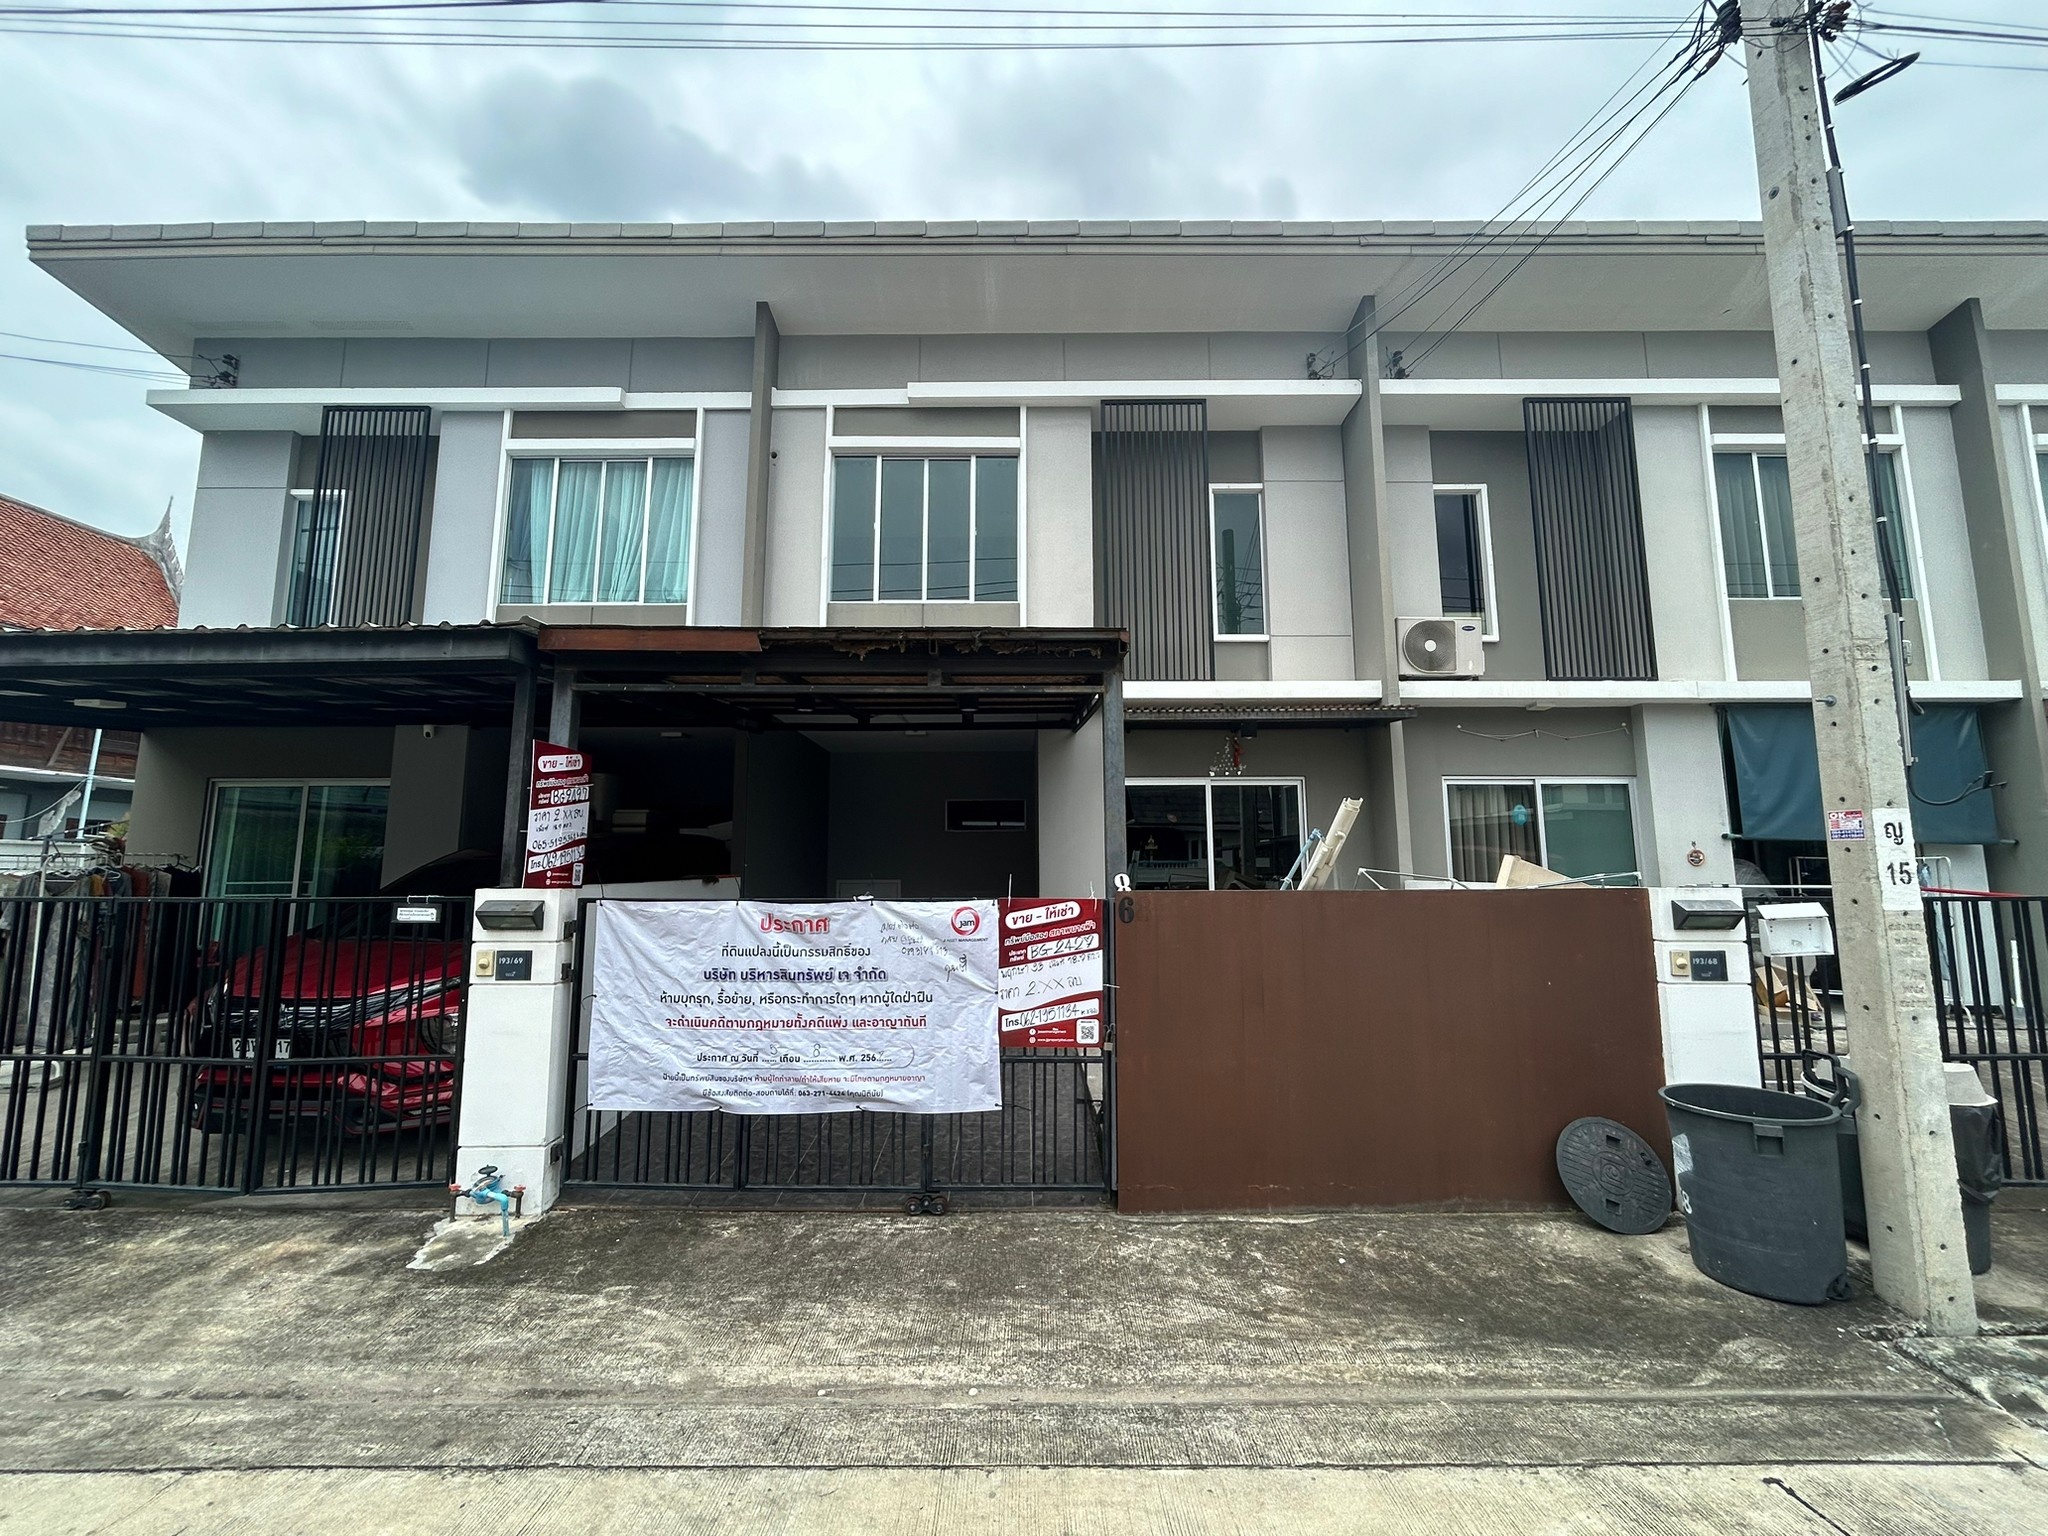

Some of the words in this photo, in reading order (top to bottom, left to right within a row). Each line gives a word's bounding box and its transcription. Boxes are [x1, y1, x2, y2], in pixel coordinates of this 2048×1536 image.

[542, 760, 558, 769] ขาย
[565, 756, 580, 768] ให้เช่า
[533, 811, 551, 822] ราคา
[1884, 822, 1904, 846] ญ
[1887, 861, 1913, 886] 15
[1011, 913, 1033, 926] ขาย
[1044, 904, 1074, 920] ให้เช่า
[1119, 897, 1134, 923] 6
[759, 913, 830, 934] ประกาศ
[958, 919, 975, 929] jam
[1004, 931, 1048, 947] ทรัพย์มือสอง
[721, 944, 871, 958] ที่ดินแปลงนี้เป็นกรรมสิทธิ์ของ
[498, 957, 524, 965] 193/69
[1692, 957, 1718, 965] 193/68
[702, 967, 737, 981] บริษัท
[740, 967, 835, 982] บริหารสินทรัพย์
[837, 970, 850, 982] เจ
[853, 966, 888, 982] จำกัด
[660, 990, 714, 1007] ห้ามบุกรุก,
[717, 988, 755, 1006] รื้อย้าย,
[759, 990, 856, 1006] หรือกระทำการใดๆ
[860, 989, 933, 1007] หากผู้ใดฝ่าฝืน
[1000, 986, 1020, 1000] ราคา
[665, 1012, 848, 1031] จะดำเนินคดีตามกฎหมายทั้งคดีแพ่ง
[852, 1013, 927, 1029] และอาญาทันที
[697, 1052, 728, 1063] ประกาศ
[730, 1053, 739, 1063] ณ
[741, 1050, 759, 1063] วันที่
[780, 1051, 800, 1063] เดือน
[839, 1053, 858, 1063] พ.ศ.
